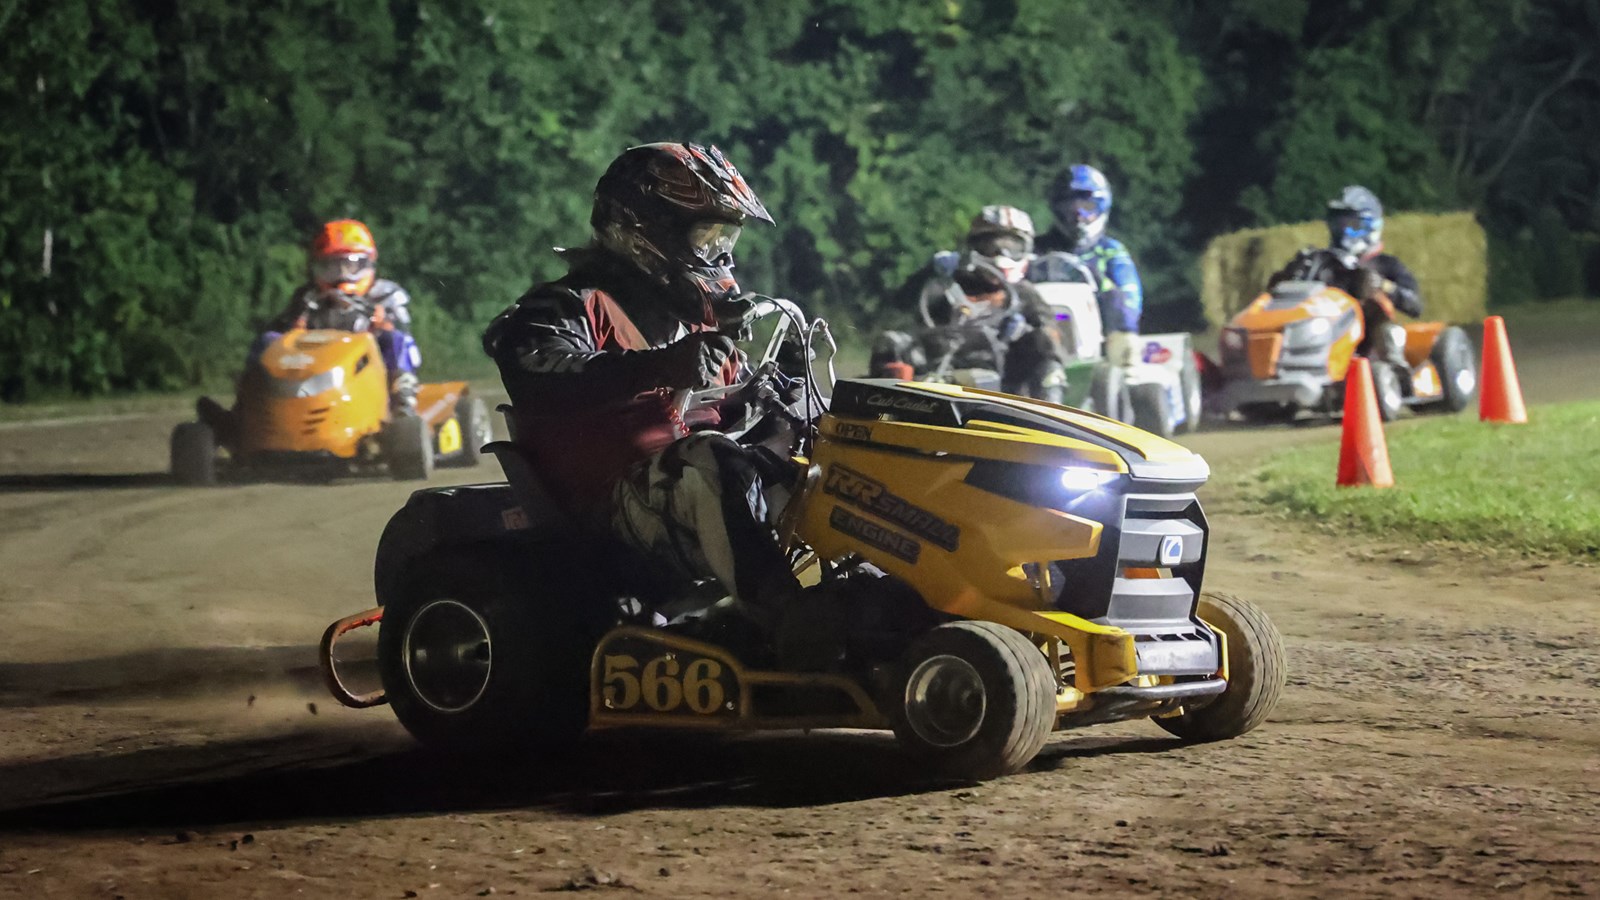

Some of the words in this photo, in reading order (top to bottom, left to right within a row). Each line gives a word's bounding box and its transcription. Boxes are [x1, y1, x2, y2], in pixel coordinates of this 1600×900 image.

[866, 393, 893, 406] Cub
[893, 397, 940, 413] Cadet
[832, 510, 918, 557] ENGINE
[874, 495, 958, 544] SMALL
[603, 655, 724, 714] 566
